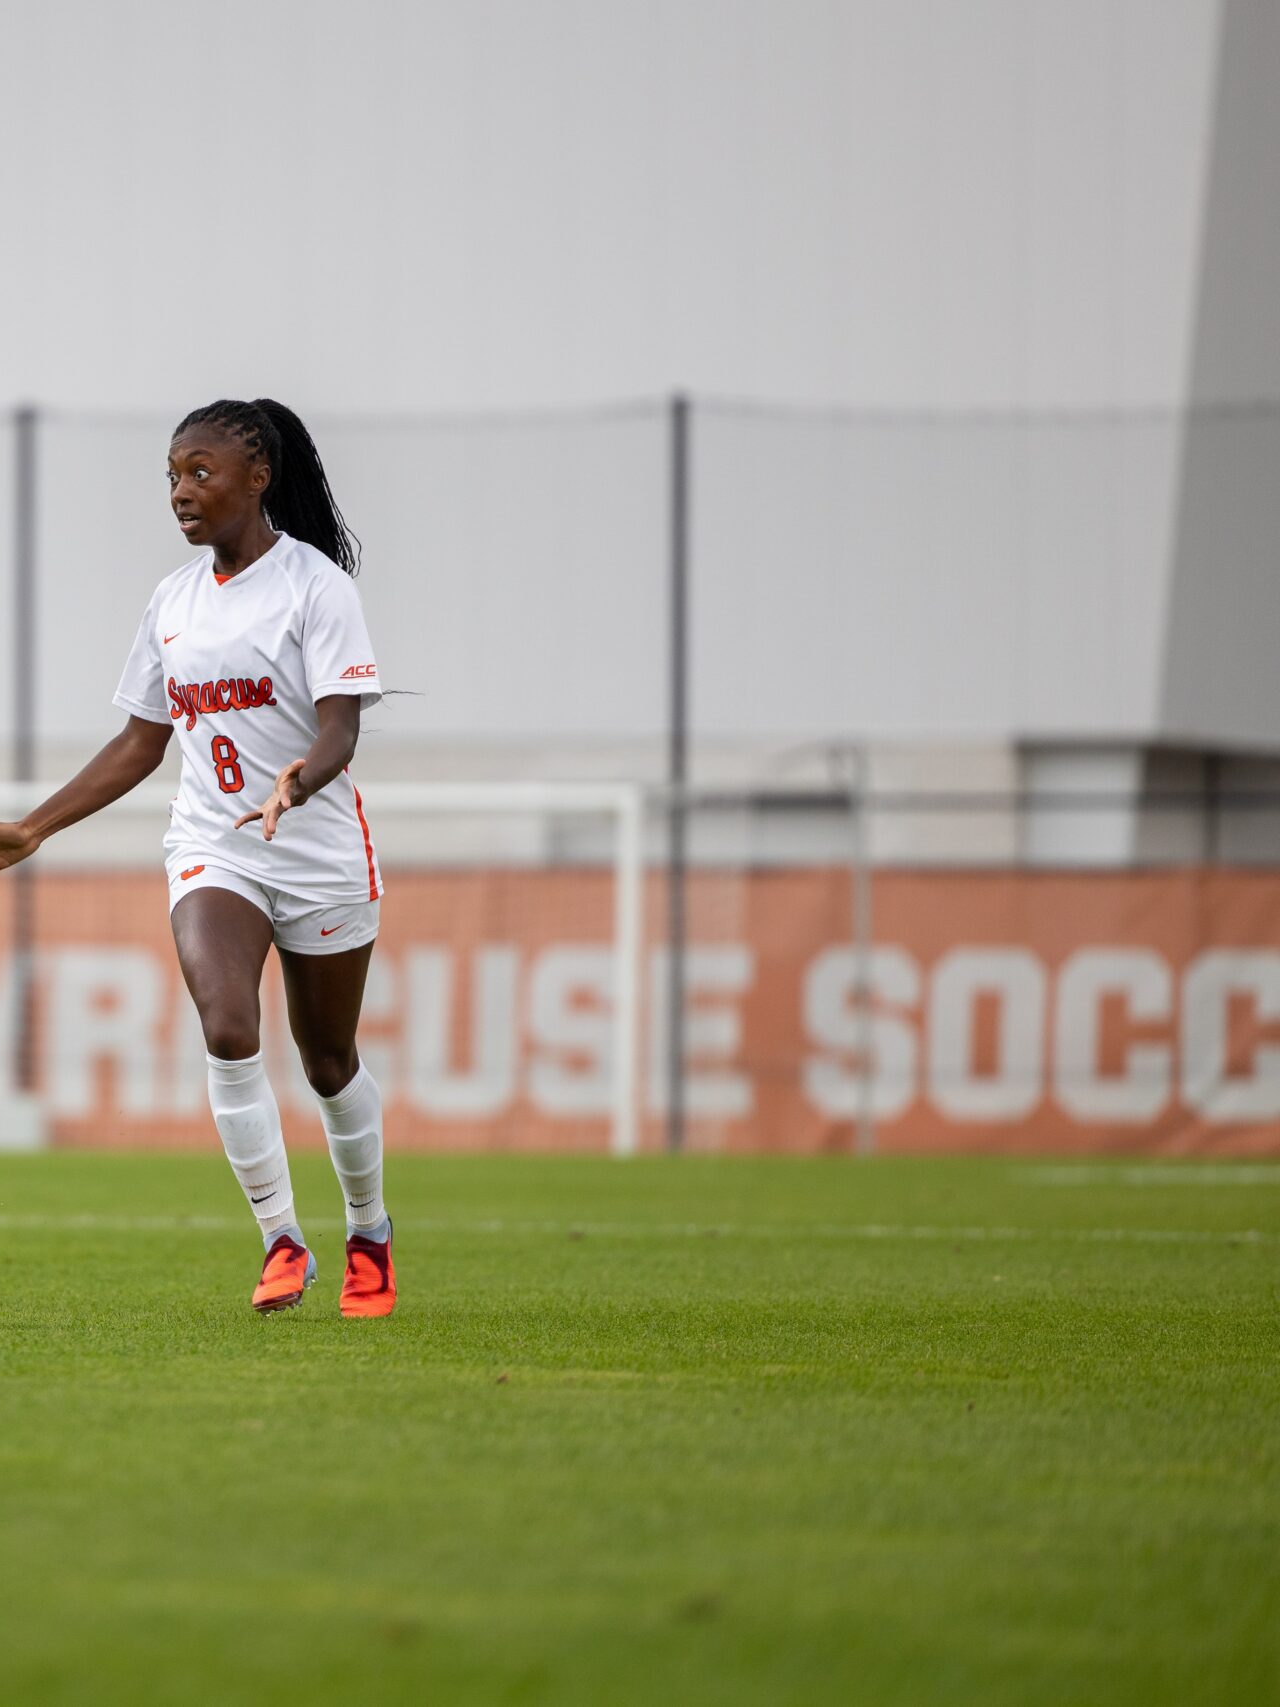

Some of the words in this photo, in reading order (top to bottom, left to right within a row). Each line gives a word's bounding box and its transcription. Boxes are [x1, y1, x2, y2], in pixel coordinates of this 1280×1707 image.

[340, 664, 376, 678] ACC
[168, 676, 277, 731] Syracuse
[211, 735, 245, 793] 8
